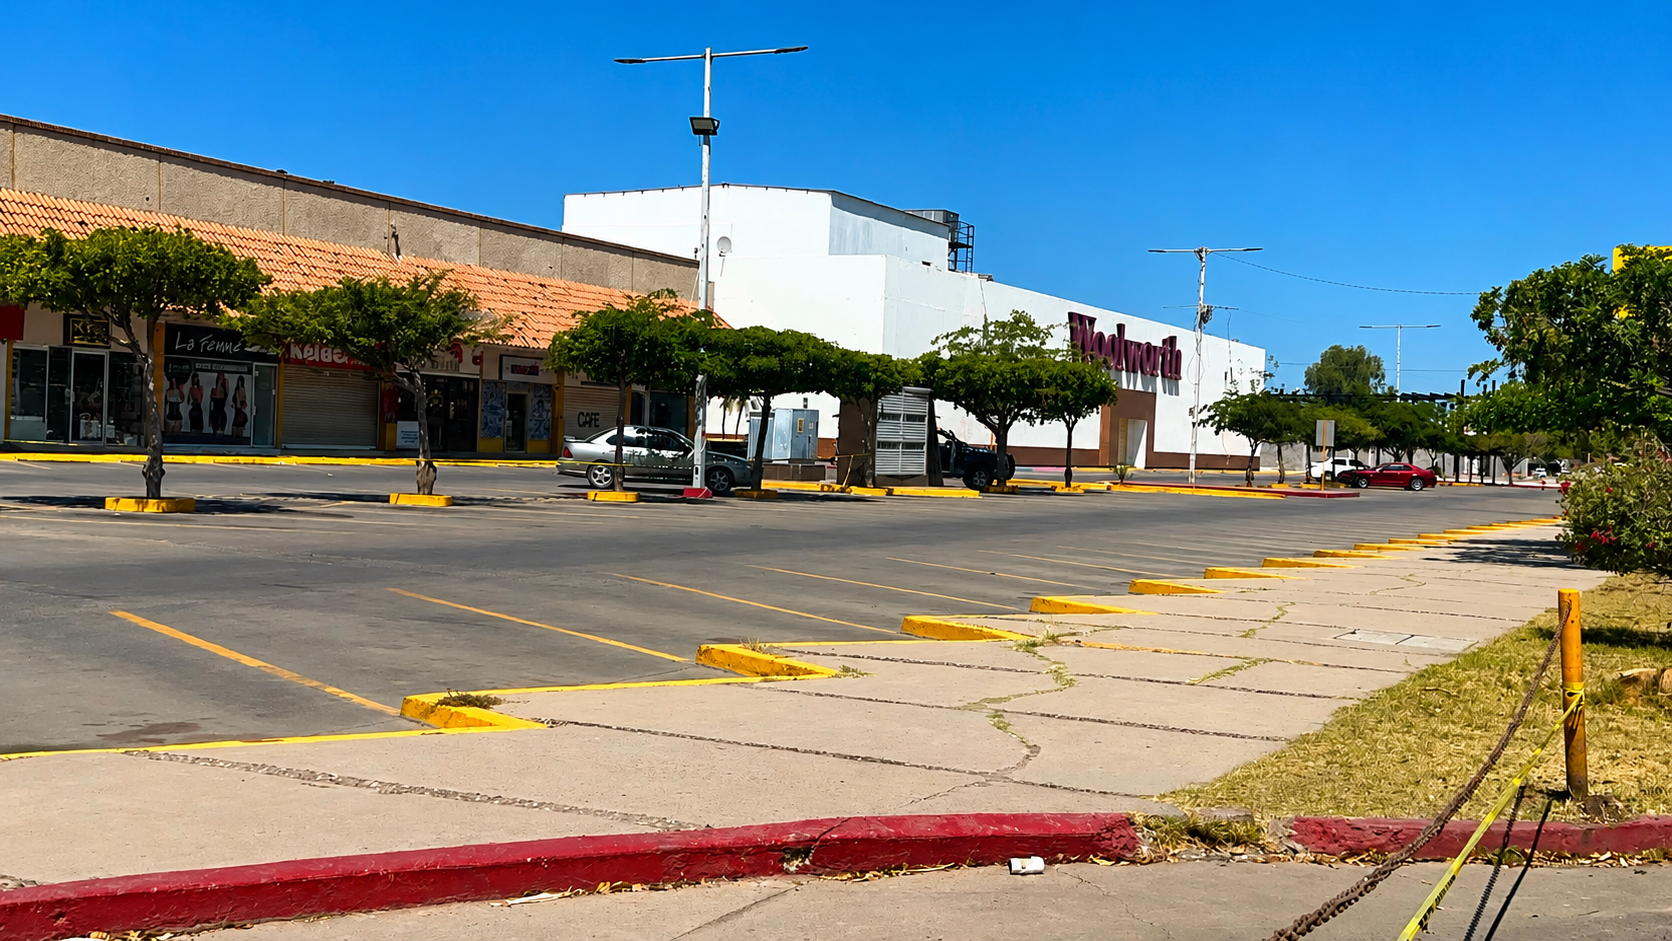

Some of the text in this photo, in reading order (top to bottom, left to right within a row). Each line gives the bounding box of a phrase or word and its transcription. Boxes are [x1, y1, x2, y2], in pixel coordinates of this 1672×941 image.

[175, 331, 195, 351] La
[1068, 311, 1182, 380] Woolworth
[577, 411, 600, 428] CAFE
